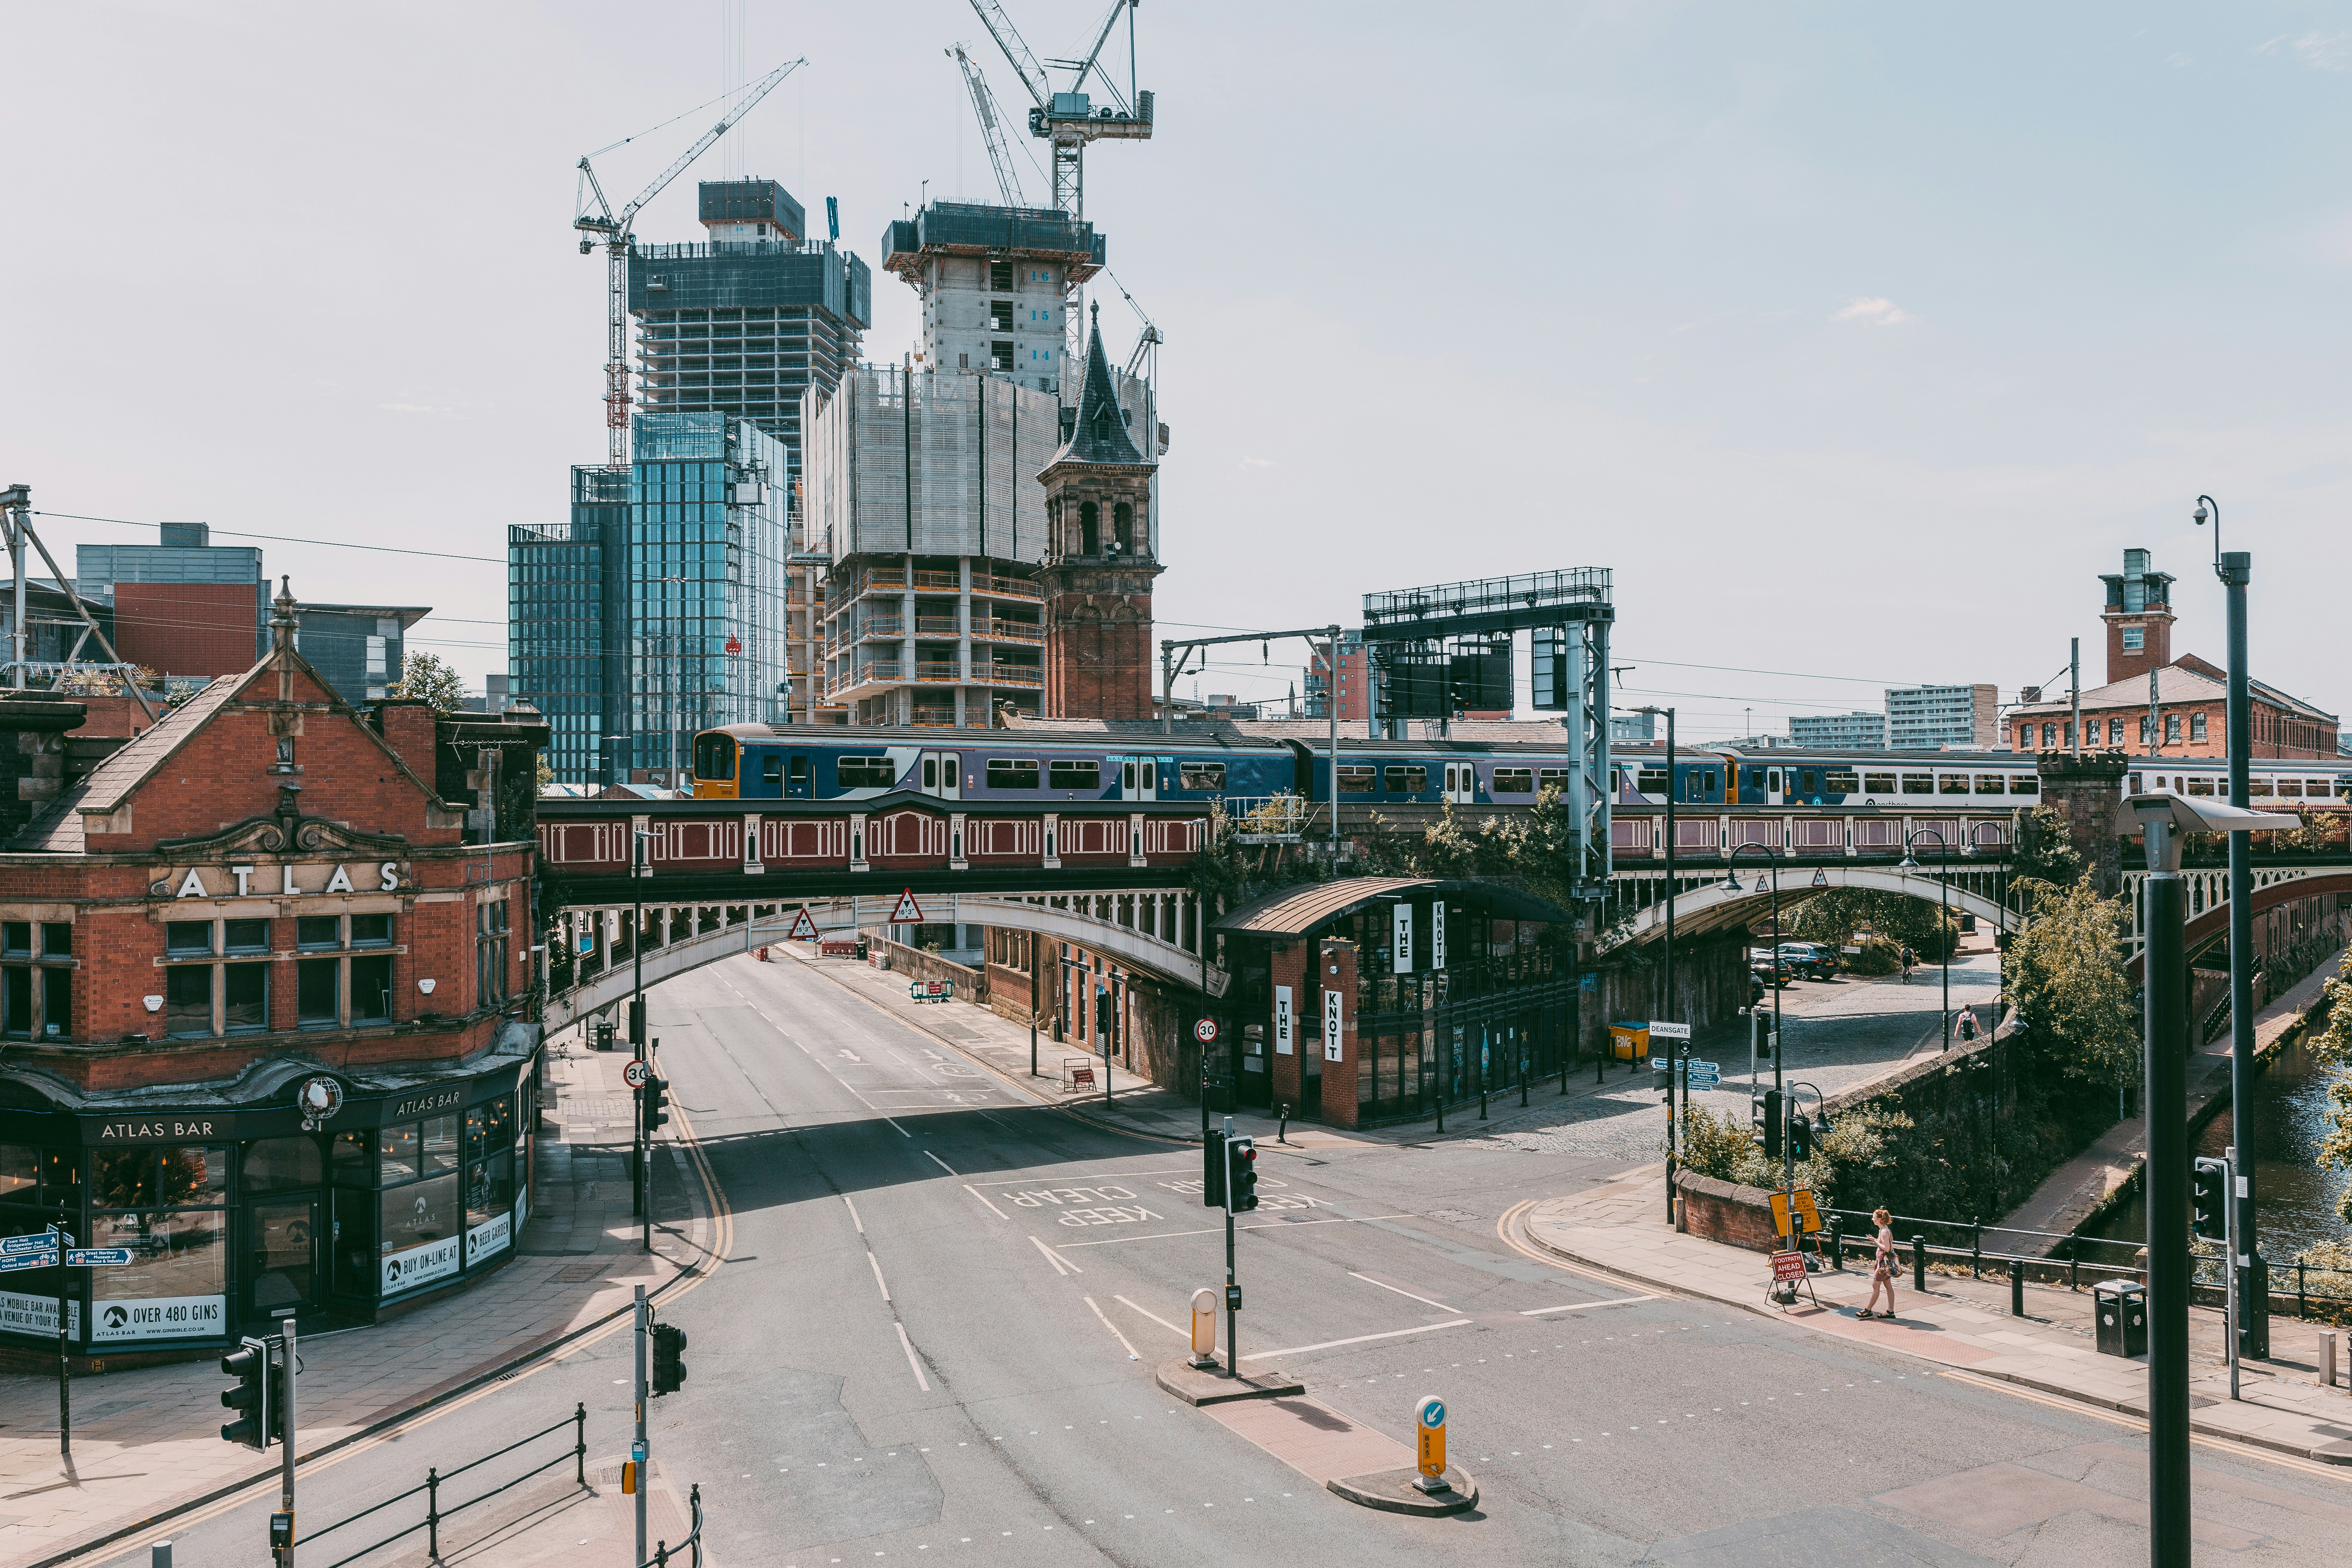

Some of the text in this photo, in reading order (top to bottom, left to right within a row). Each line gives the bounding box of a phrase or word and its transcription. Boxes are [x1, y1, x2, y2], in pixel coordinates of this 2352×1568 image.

[1032, 270, 1049, 282] 16
[1032, 310, 1049, 321] 15
[1032, 350, 1049, 360] 14
[177, 862, 398, 897] ATLAS
[1400, 919, 1408, 959] THE
[1200, 1025, 1215, 1035] 30
[1329, 993, 1337, 1059] KNOTT
[1652, 1026, 1688, 1034] DEANSGATE
[397, 1092, 459, 1116] ATLAS BAR
[101, 1122, 213, 1137] ATLAS BAR
[1002, 1186, 1137, 1207] CLEAR
[406, 1214, 435, 1228] ATLAS
[1058, 1206, 1165, 1227] KEEP
[479, 1220, 508, 1247] BEER GARDEN
[404, 1245, 457, 1274] BUY ON-LINE AT
[1774, 1255, 1801, 1264] FOOTPATH
[1778, 1262, 1801, 1272] AHEAD
[1777, 1271, 1804, 1280] CLOSED
[383, 1283, 396, 1291] ATLAS
[7, 1298, 29, 1311] MOBILE
[31, 1301, 43, 1313] BAR
[45, 1303, 77, 1317] AVAIBLE
[134, 1304, 217, 1323] OVER 480 GINS
[4, 1310, 23, 1323] VENUE
[25, 1313, 33, 1324] OF
[35, 1314, 51, 1327] YOUR
